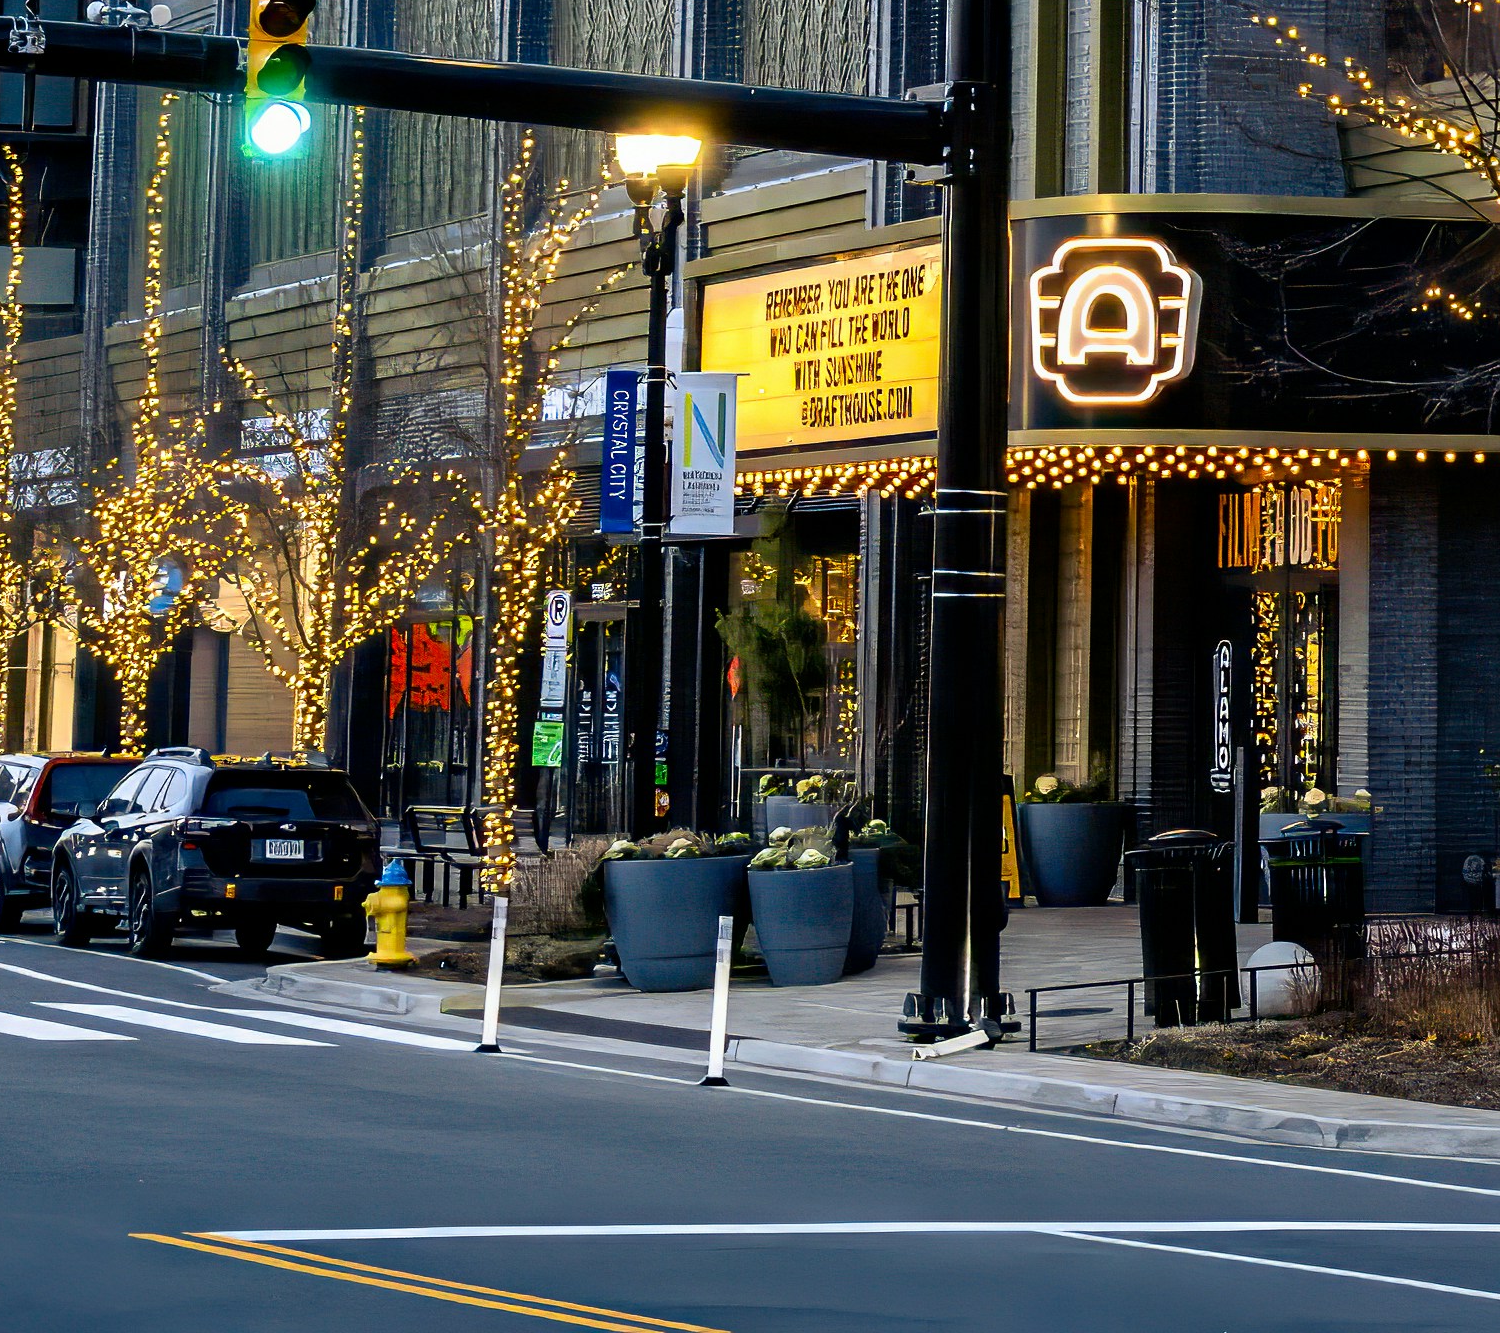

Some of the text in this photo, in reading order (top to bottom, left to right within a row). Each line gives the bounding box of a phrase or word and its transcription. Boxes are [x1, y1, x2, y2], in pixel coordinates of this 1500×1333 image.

[828, 277, 851, 312] YOU
[852, 273, 875, 307] ARE
[901, 264, 926, 298] ONE
[819, 317, 844, 351] FILL
[848, 313, 868, 346] THE
[794, 350, 883, 391] WITH SUNSHINE
[610, 390, 630, 460] CRYSTAL
[609, 463, 627, 500] CITY
[1218, 645, 1231, 769] ALAMO
